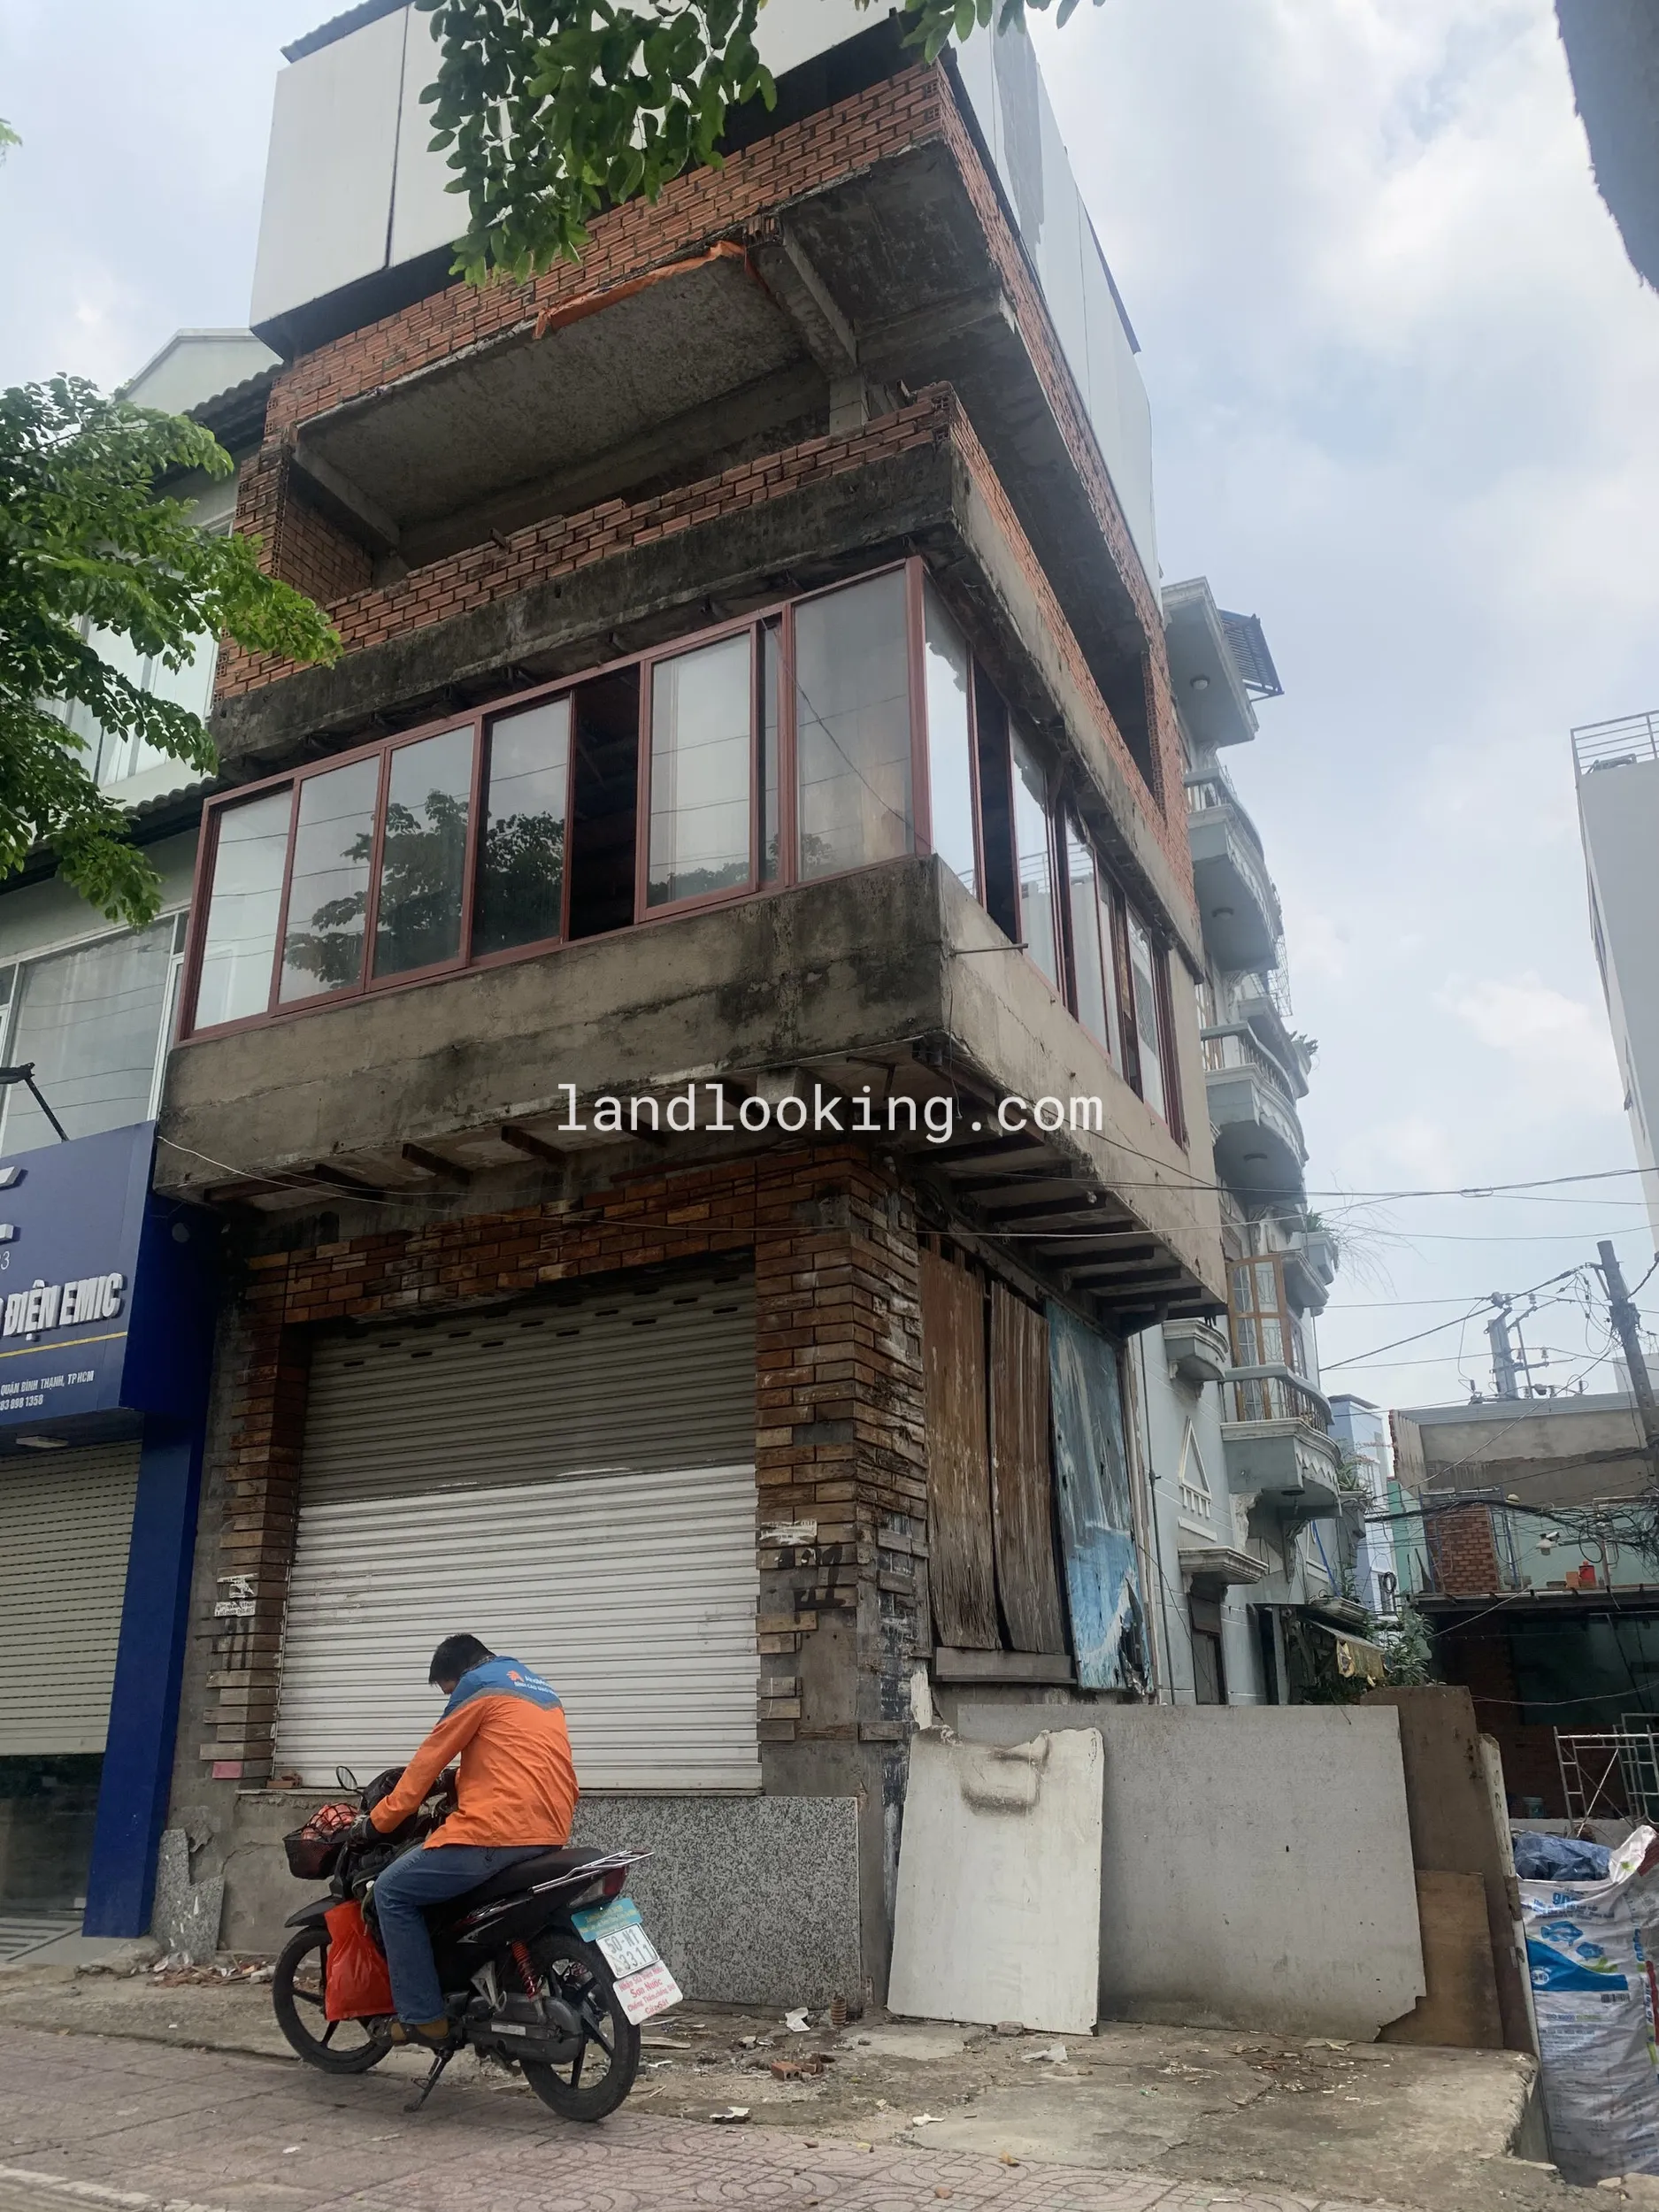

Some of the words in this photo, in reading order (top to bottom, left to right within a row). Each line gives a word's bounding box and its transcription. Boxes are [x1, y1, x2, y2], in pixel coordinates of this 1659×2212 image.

[3, 1279, 61, 1341] ĐIỆN
[59, 1272, 124, 1325] EMIC
[1, 1381, 19, 1396] QUẬN
[21, 1379, 39, 1392] BÌNH
[26, 1394, 43, 1406] 1358
[604, 1928, 640, 1954] 50-N1
